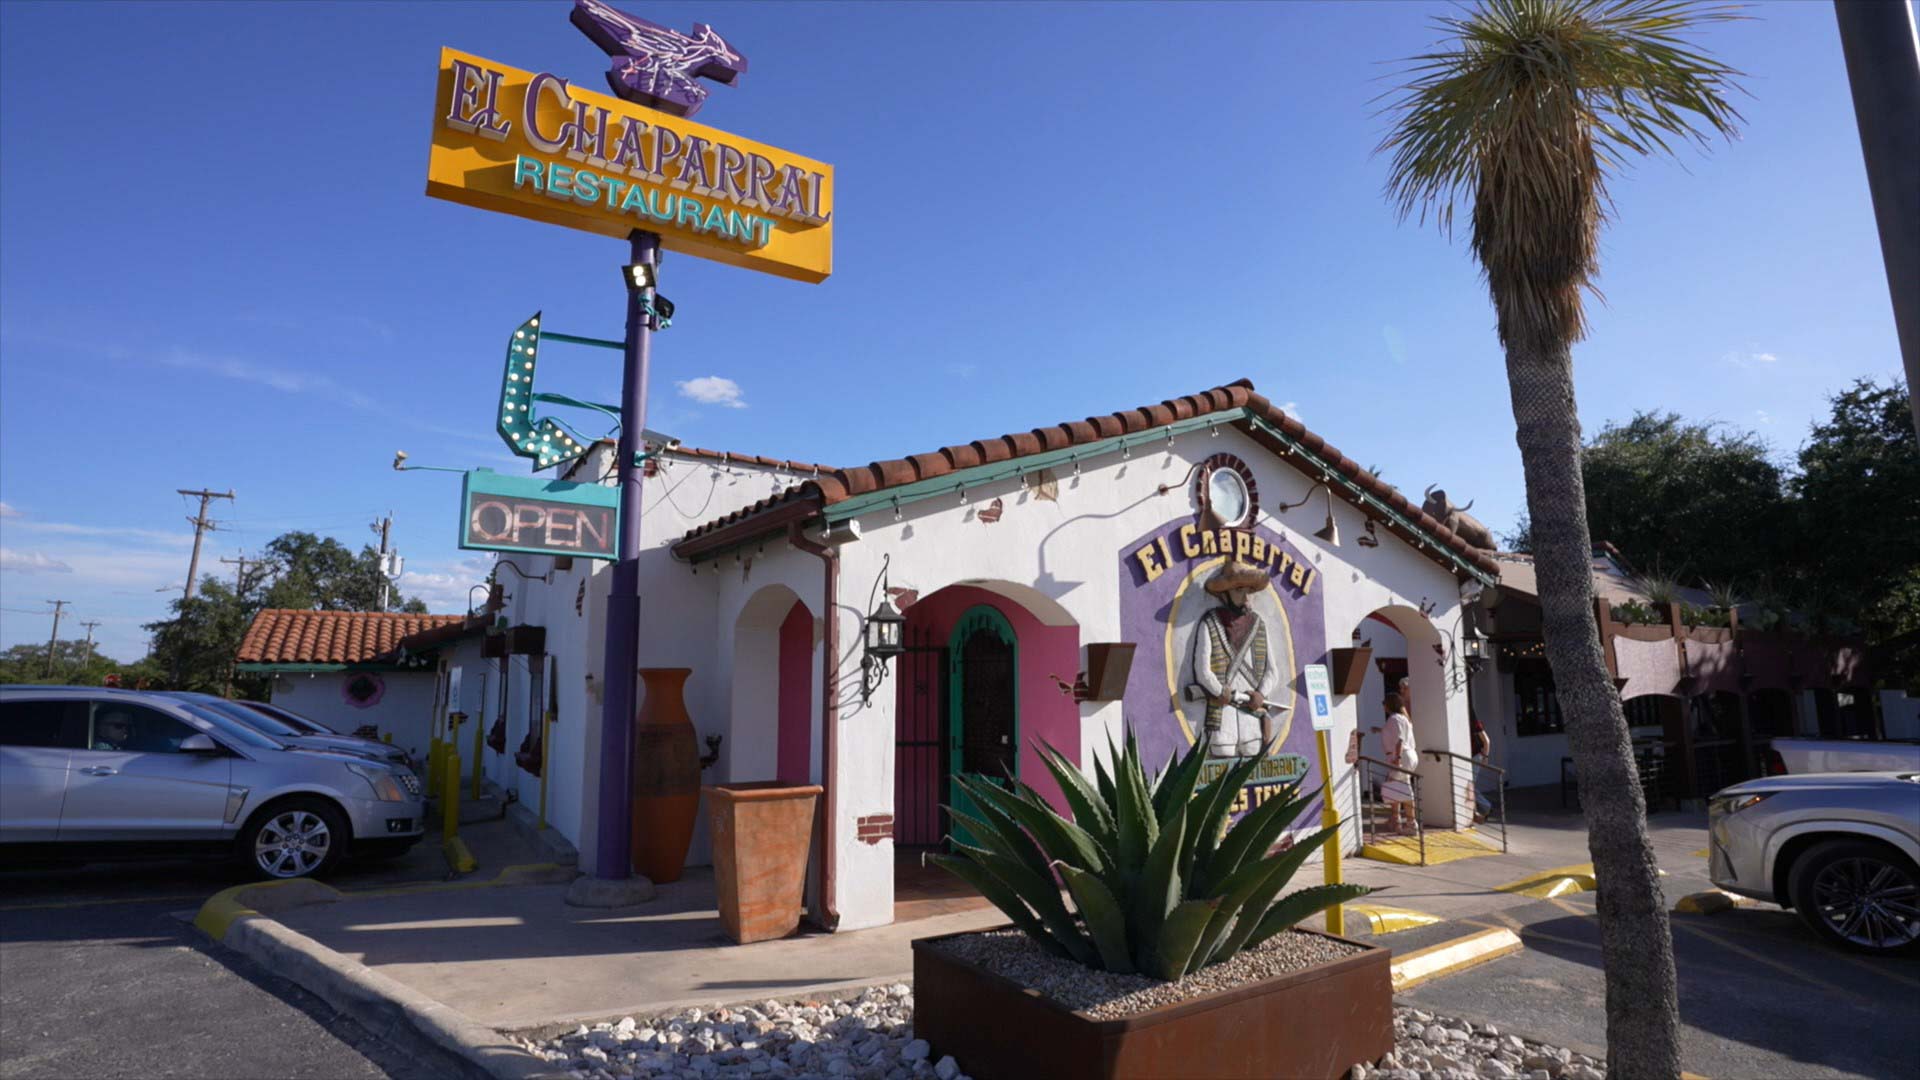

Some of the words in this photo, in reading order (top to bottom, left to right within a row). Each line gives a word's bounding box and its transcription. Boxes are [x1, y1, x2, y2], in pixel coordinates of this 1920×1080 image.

[448, 59, 511, 140] EL
[523, 72, 831, 225] CHAPARRAL
[514, 154, 776, 246] RESTAURANT
[471, 501, 609, 549] OPEN
[1136, 535, 1174, 583] El
